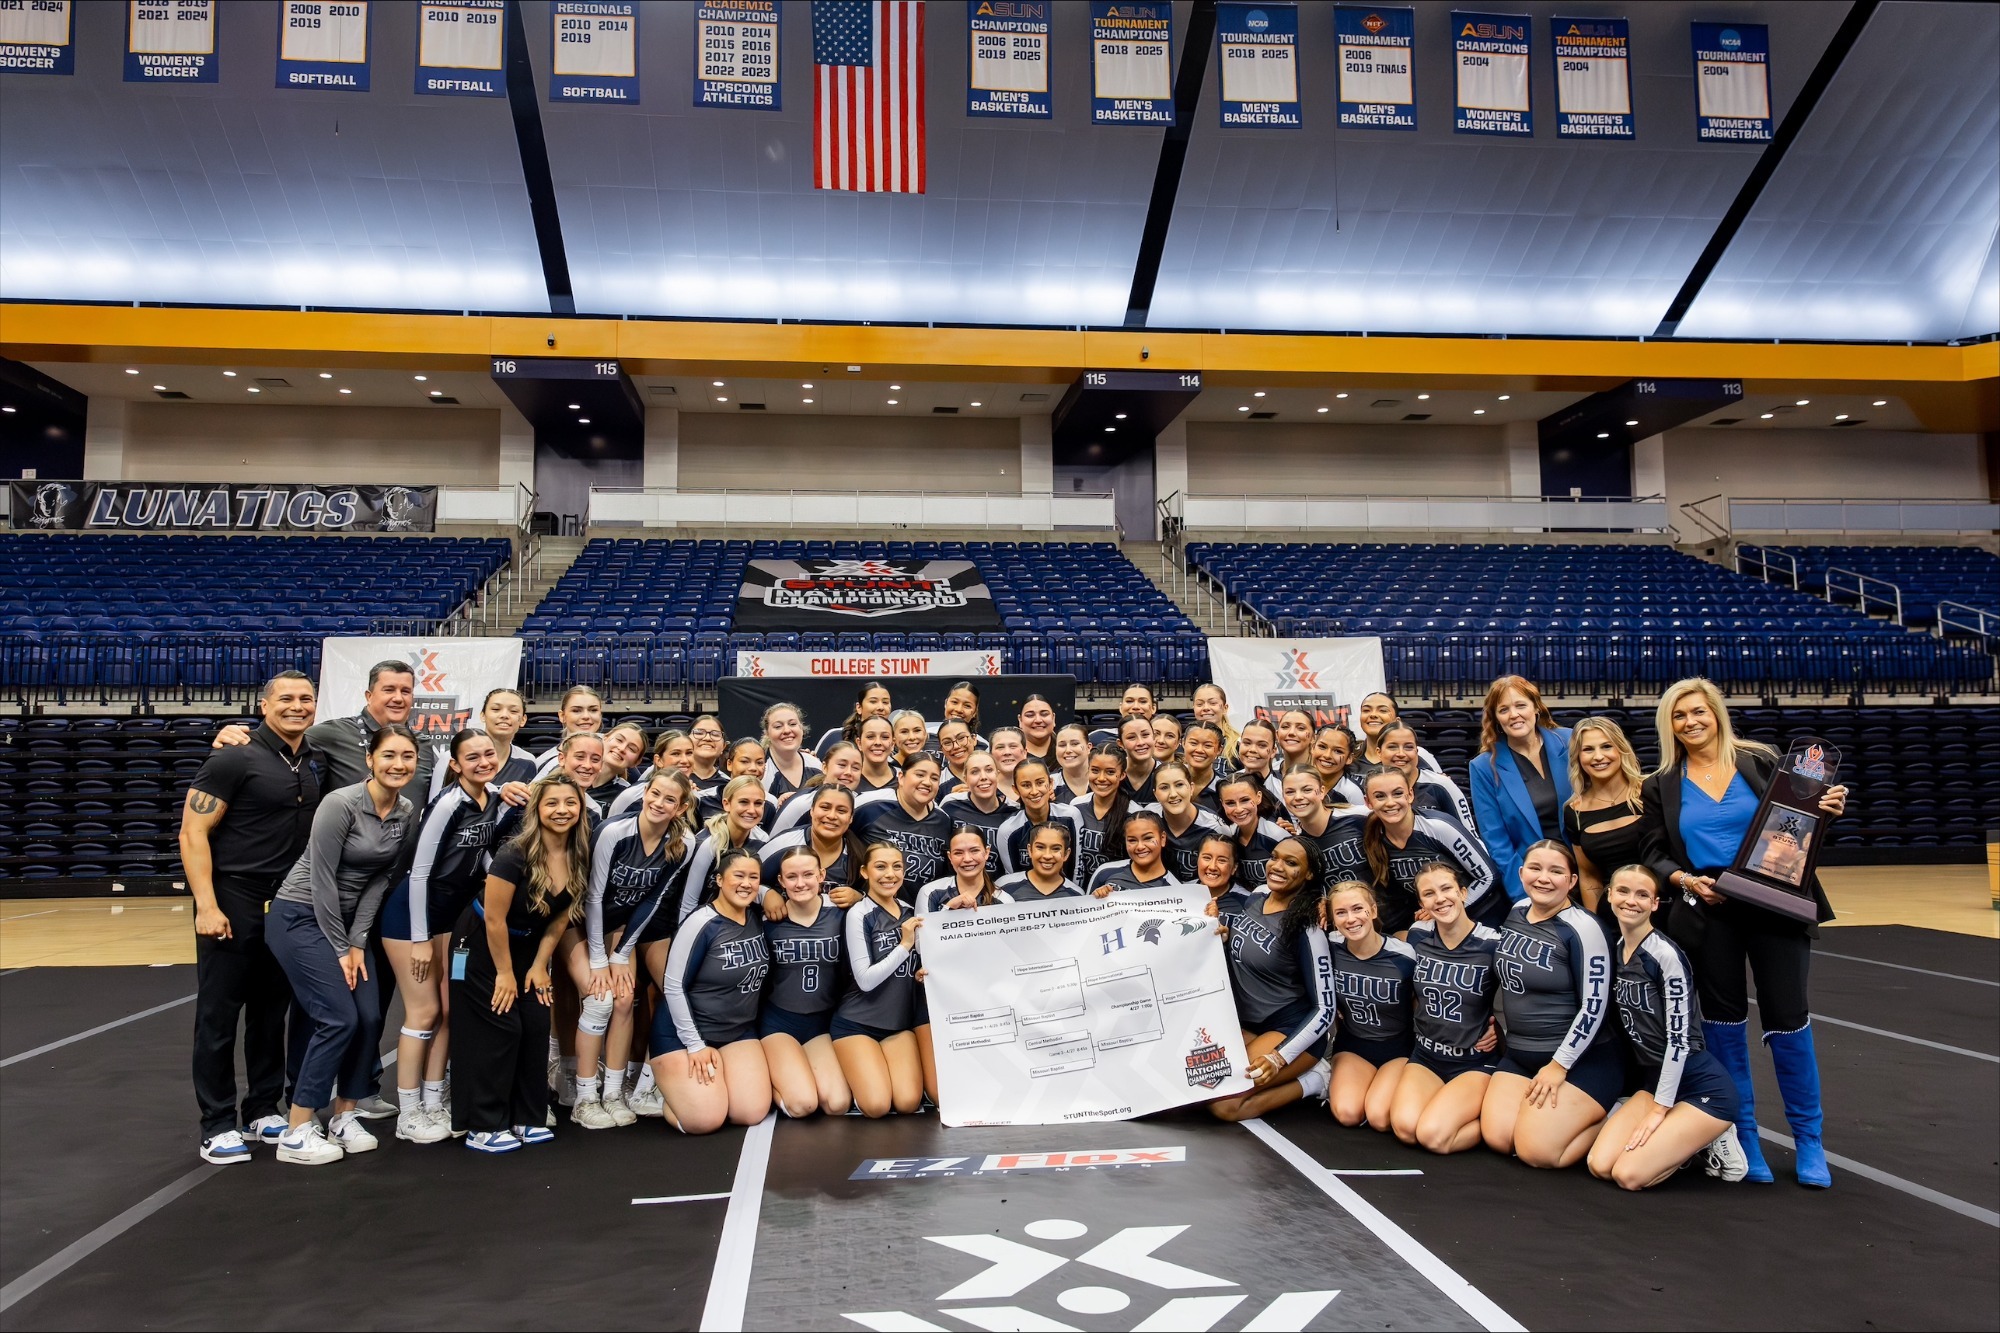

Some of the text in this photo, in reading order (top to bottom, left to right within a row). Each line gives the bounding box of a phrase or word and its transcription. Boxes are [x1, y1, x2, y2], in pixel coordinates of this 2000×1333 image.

[0, 1, 63, 12] 021 2024
[290, 4, 359, 17] 2008 2010
[557, 3, 632, 15] REGIONALS
[704, 0, 773, 11] ACADEMIC
[976, 2, 1043, 18] ASUN
[138, 10, 208, 21] 2021 2024
[428, 11, 497, 24] 2010 2019
[699, 9, 778, 22] CHAMPIONS
[290, 18, 321, 29] 2019
[561, 19, 628, 31] 2010 2014
[971, 20, 1048, 33] CHAMPIONS
[1094, 18, 1169, 30] TOURNAMENT
[706, 26, 771, 38] 2010 2014
[1094, 29, 1169, 40] CHAMPIONS
[1460, 23, 1523, 39] ASUN
[561, 32, 591, 43] 2019
[978, 36, 1041, 48] 2006 2010
[1221, 33, 1294, 44] TOURNAMENT
[1338, 34, 1410, 46] TOURNAMENT
[1556, 36, 1626, 47] TOURNAMENT
[706, 39, 771, 51] 2015 2016
[1101, 44, 1163, 56] 2018 2025
[1456, 41, 1528, 54] CHAMPIONS
[978, 49, 1041, 61] 2019 2025
[1228, 49, 1289, 59] 2018 2025
[1345, 50, 1372, 60] 2006
[1556, 46, 1627, 57] CHAMPIONS
[1697, 50, 1766, 63] TOURNAMENT
[0, 57, 54, 68] SOCCER
[139, 55, 204, 66] WOMEN'S
[706, 52, 771, 65] 2017 2019
[1463, 56, 1489, 67] 2004
[144, 67, 198, 77] SOCCER
[705, 65, 771, 78] 2022 2023
[1346, 63, 1407, 74] 2019 FINALS
[1563, 61, 1589, 72] 2004
[1704, 65, 1729, 76] 2004
[289, 73, 356, 86] SOFTBALL
[428, 79, 493, 92] SOFTBALL
[563, 87, 627, 99] SOFTBALL
[704, 82, 772, 94] LIPSCOMB
[703, 93, 773, 105] ATHLETICS
[990, 92, 1029, 103] MEN'S
[971, 102, 1048, 114] BASKETBALL
[1114, 100, 1152, 110] MEN'S
[1242, 103, 1280, 113] MEN'S
[1358, 104, 1395, 115] MEN'S
[1096, 110, 1172, 121] BASKETBALL
[1224, 113, 1299, 124] BASKETBALL
[1341, 114, 1414, 126] BASKETBALL
[1466, 109, 1521, 121] WOMEN'S
[1567, 114, 1623, 125] WOMEN'S
[1457, 119, 1530, 132] BASKETBALL
[1561, 124, 1632, 135] BASKETBALL
[1708, 118, 1763, 129] WOMEN'S
[1701, 128, 1771, 139] BASKETBALL
[494, 361, 516, 373] 116
[595, 363, 617, 375] 115
[1086, 373, 1107, 385] 115
[1179, 375, 1200, 387] 114
[1637, 382, 1656, 394] 114
[1722, 383, 1742, 395] 113
[89, 488, 359, 528] LUNATICS
[785, 579, 942, 590] STUNT
[811, 658, 930, 675] COLLEGE STUNT
[411, 702, 449, 710] LEGE
[411, 712, 470, 733] UNT
[1255, 707, 1350, 728] STNT
[1794, 754, 1825, 776] USA
[1322, 837, 1367, 874] IU
[903, 854, 936, 884] 24
[941, 897, 1183, 930] 2025 College STUNT National Championship
[940, 933, 963, 941] NAIA
[964, 929, 997, 938] Division
[999, 926, 1019, 937] April
[1048, 918, 1088, 929] Lipscomb
[1088, 908, 1129, 922] University
[1100, 926, 1127, 956] H
[773, 934, 841, 965] HIU
[737, 964, 769, 994] 46
[802, 964, 819, 993] 8
[1413, 953, 1489, 996] HIU
[1495, 957, 1526, 995] 15
[1422, 986, 1462, 1023] 32
[1569, 955, 1606, 1049] STUNT
[1346, 997, 1382, 1027] 51
[1668, 977, 1685, 1062] STUNT
[1434, 1042, 1464, 1057] PRO
[1186, 1047, 1226, 1068] STUNT
[1186, 1059, 1230, 1077] NATIONAL
[1189, 1068, 1232, 1086] CHAMPIONSHIP
[1063, 1106, 1132, 1120] STUNTtheSport.org
[869, 1150, 1175, 1173] EZ Flex
